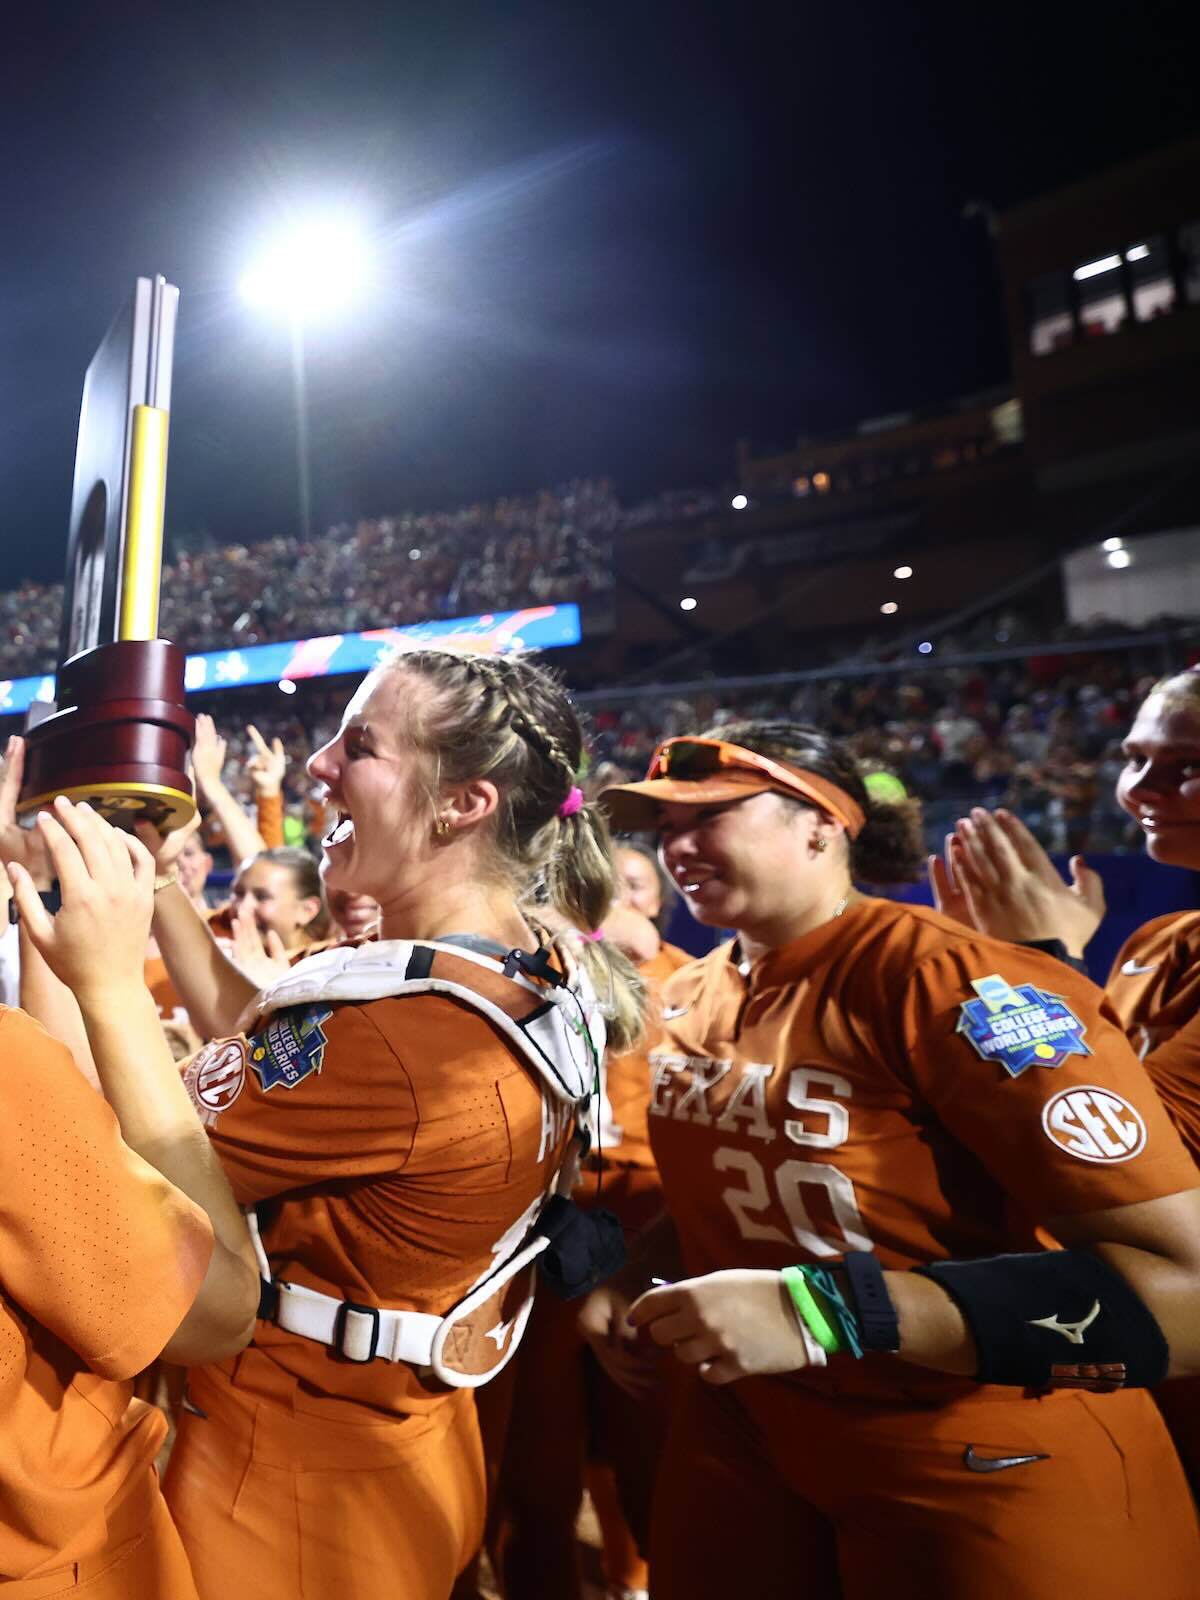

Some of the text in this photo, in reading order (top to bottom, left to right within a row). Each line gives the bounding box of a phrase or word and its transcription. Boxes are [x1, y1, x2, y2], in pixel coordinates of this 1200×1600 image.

[271, 1042, 299, 1080] SERIES
[278, 1017, 301, 1057] OLLEGE
[199, 1043, 242, 1105] SEC
[648, 1055, 852, 1149] EXAS
[1050, 1091, 1138, 1158] SEC
[713, 1147, 875, 1257] 20
